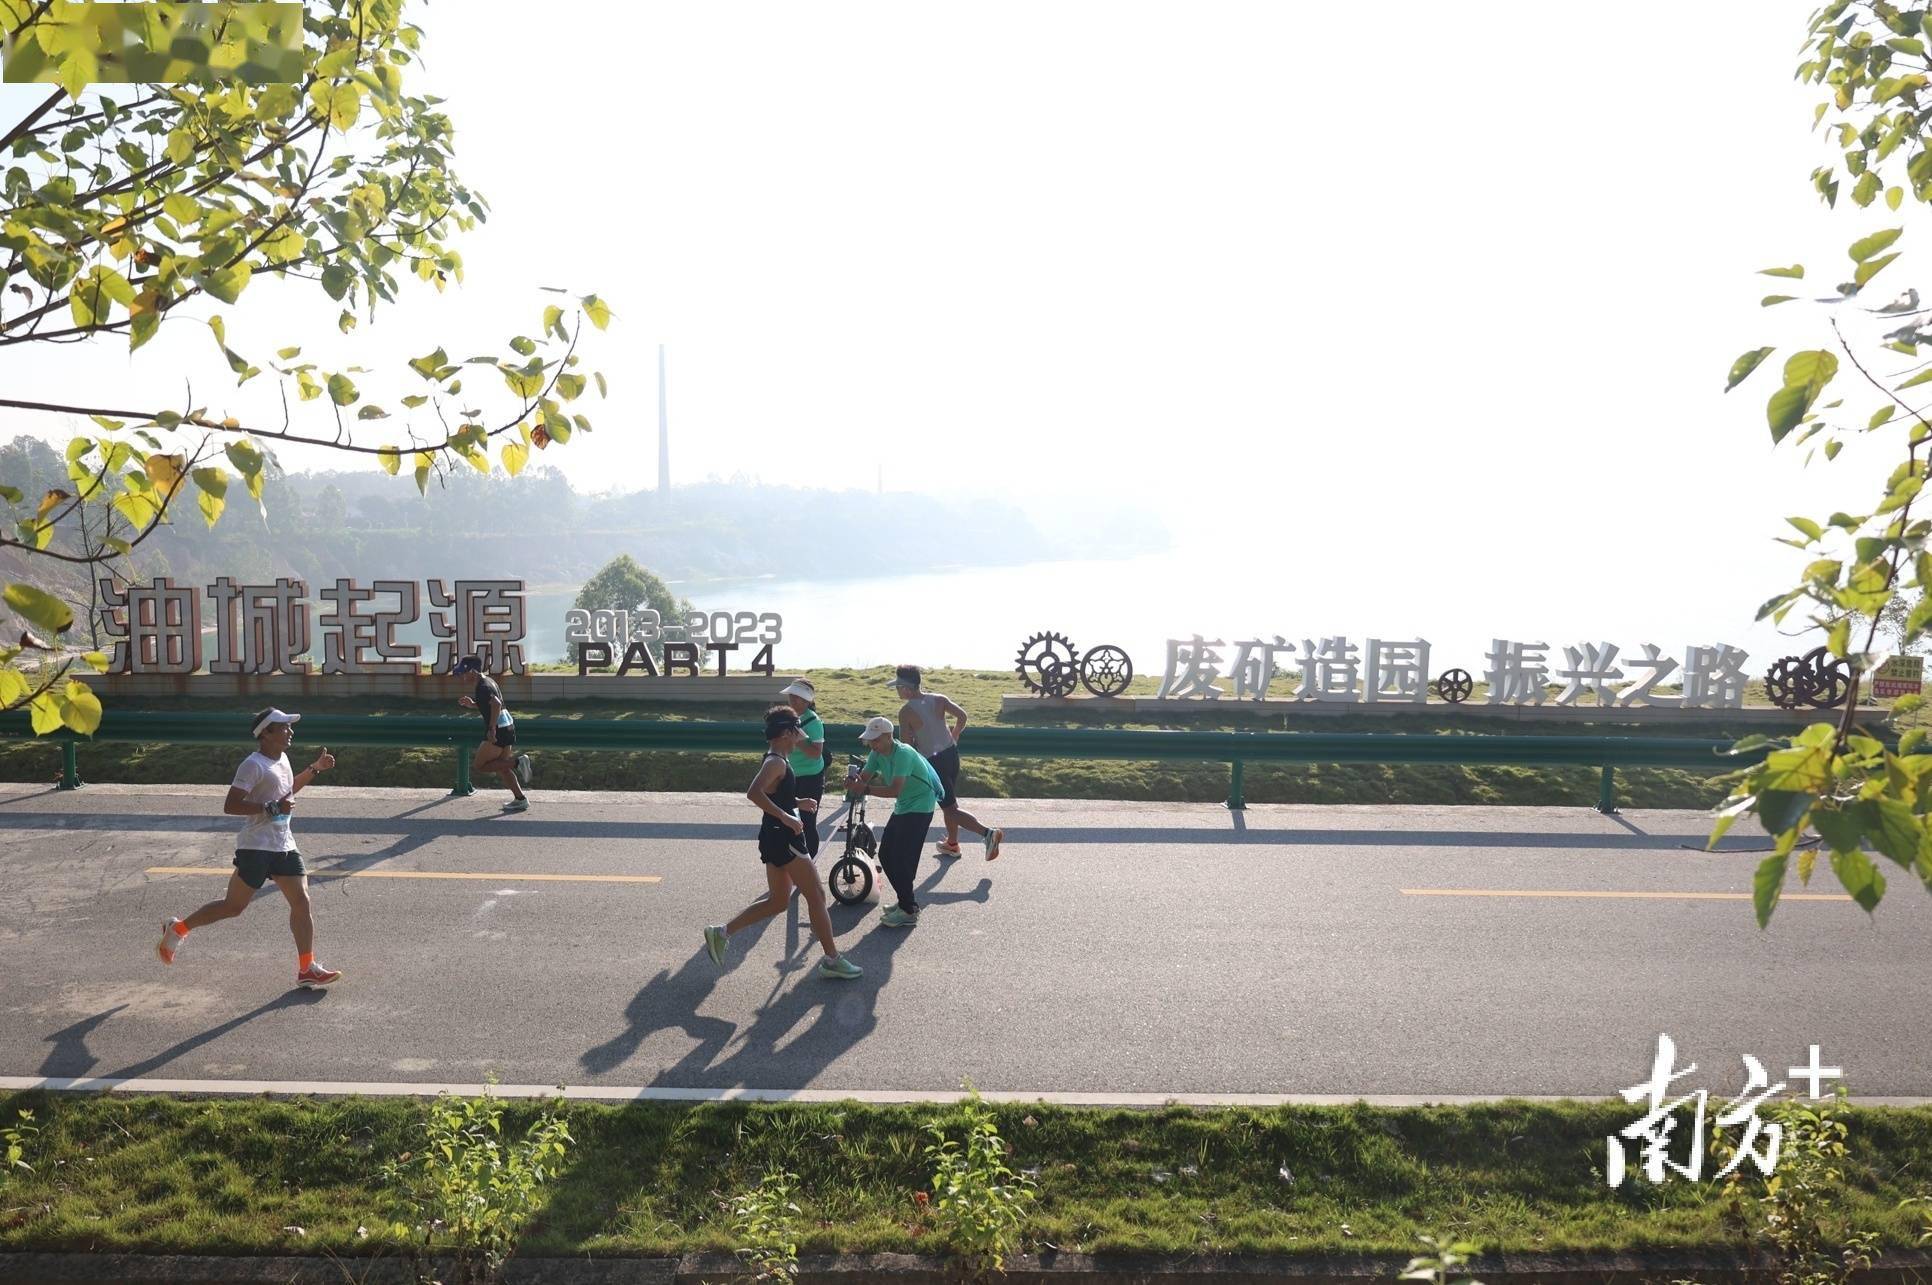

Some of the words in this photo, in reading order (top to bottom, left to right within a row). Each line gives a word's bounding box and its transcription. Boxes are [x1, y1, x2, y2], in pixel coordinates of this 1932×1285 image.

[100, 577, 529, 675] 油城起源
[565, 609, 783, 644] 2013-2023
[578, 641, 738, 677] PART
[751, 644, 775, 677] 4
[1157, 634, 1432, 704] 废矿造园
[1483, 638, 1750, 709] 振兴之路
